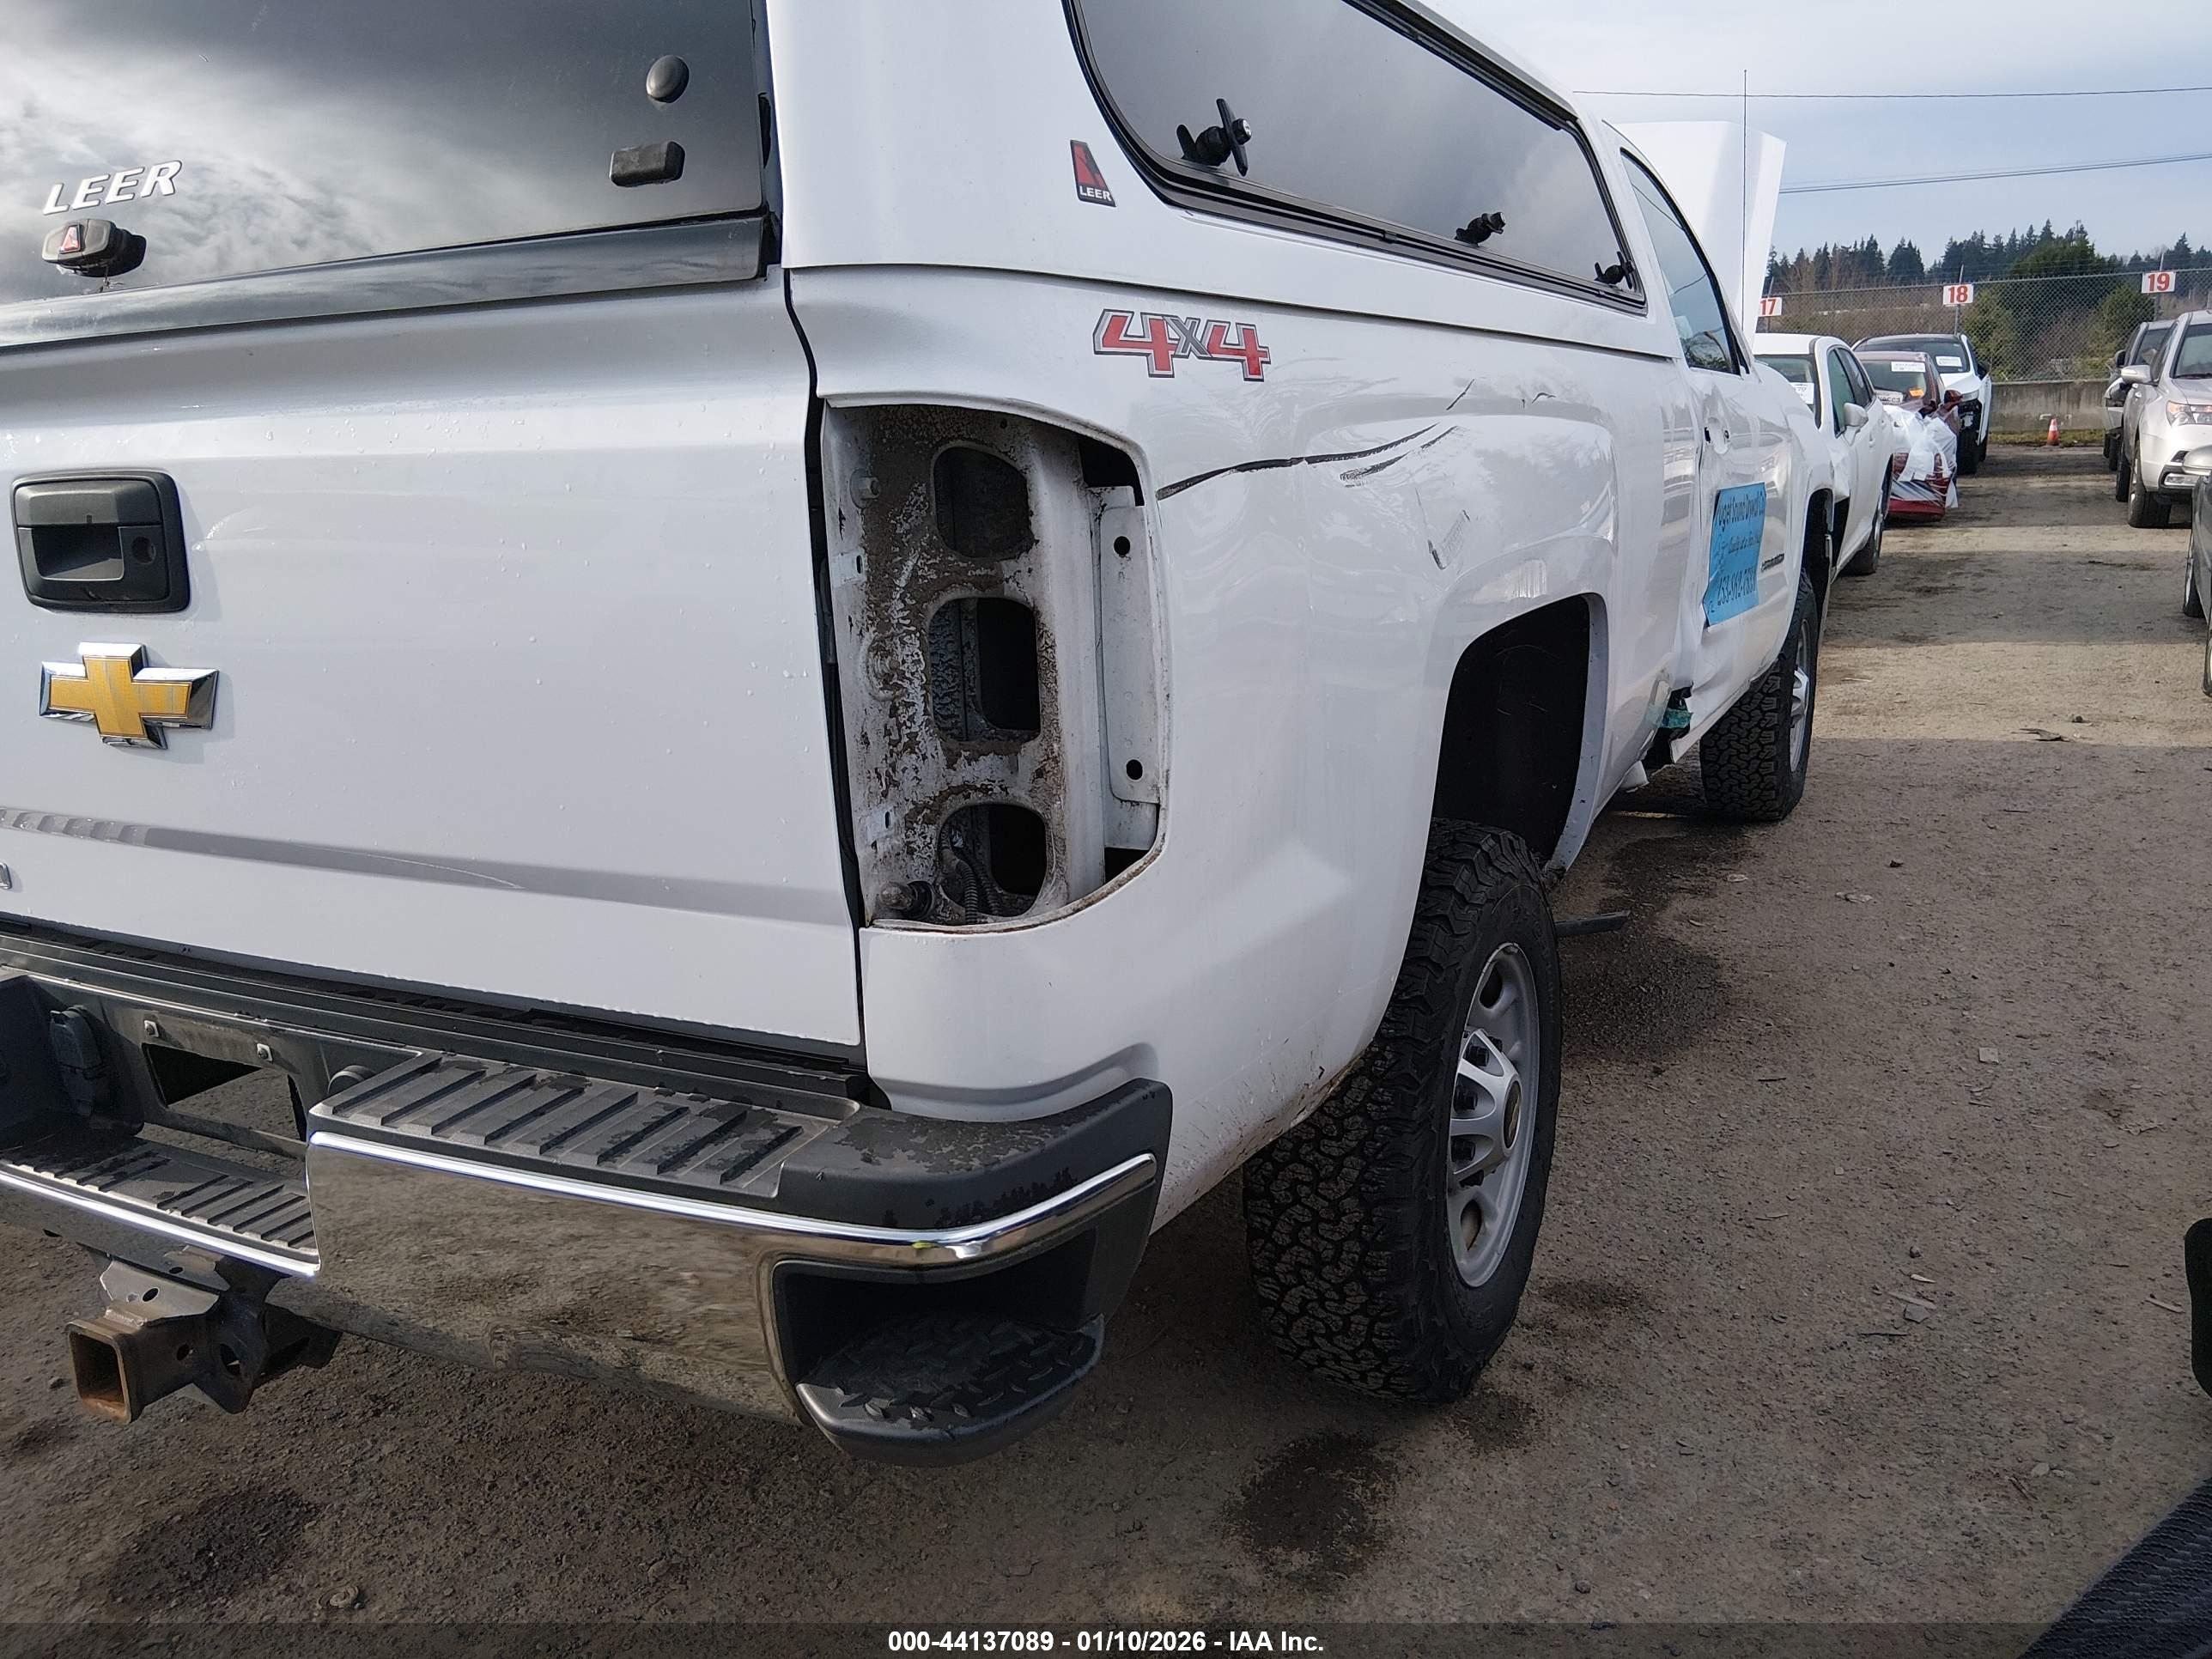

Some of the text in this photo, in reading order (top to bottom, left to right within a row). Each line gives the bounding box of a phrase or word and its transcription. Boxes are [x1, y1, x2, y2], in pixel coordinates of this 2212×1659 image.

[43, 160, 183, 216] LEER
[1079, 185, 1113, 202] LEER
[2148, 272, 2171, 292] 19
[1948, 285, 1968, 303] 18
[1759, 298, 1777, 315] 17
